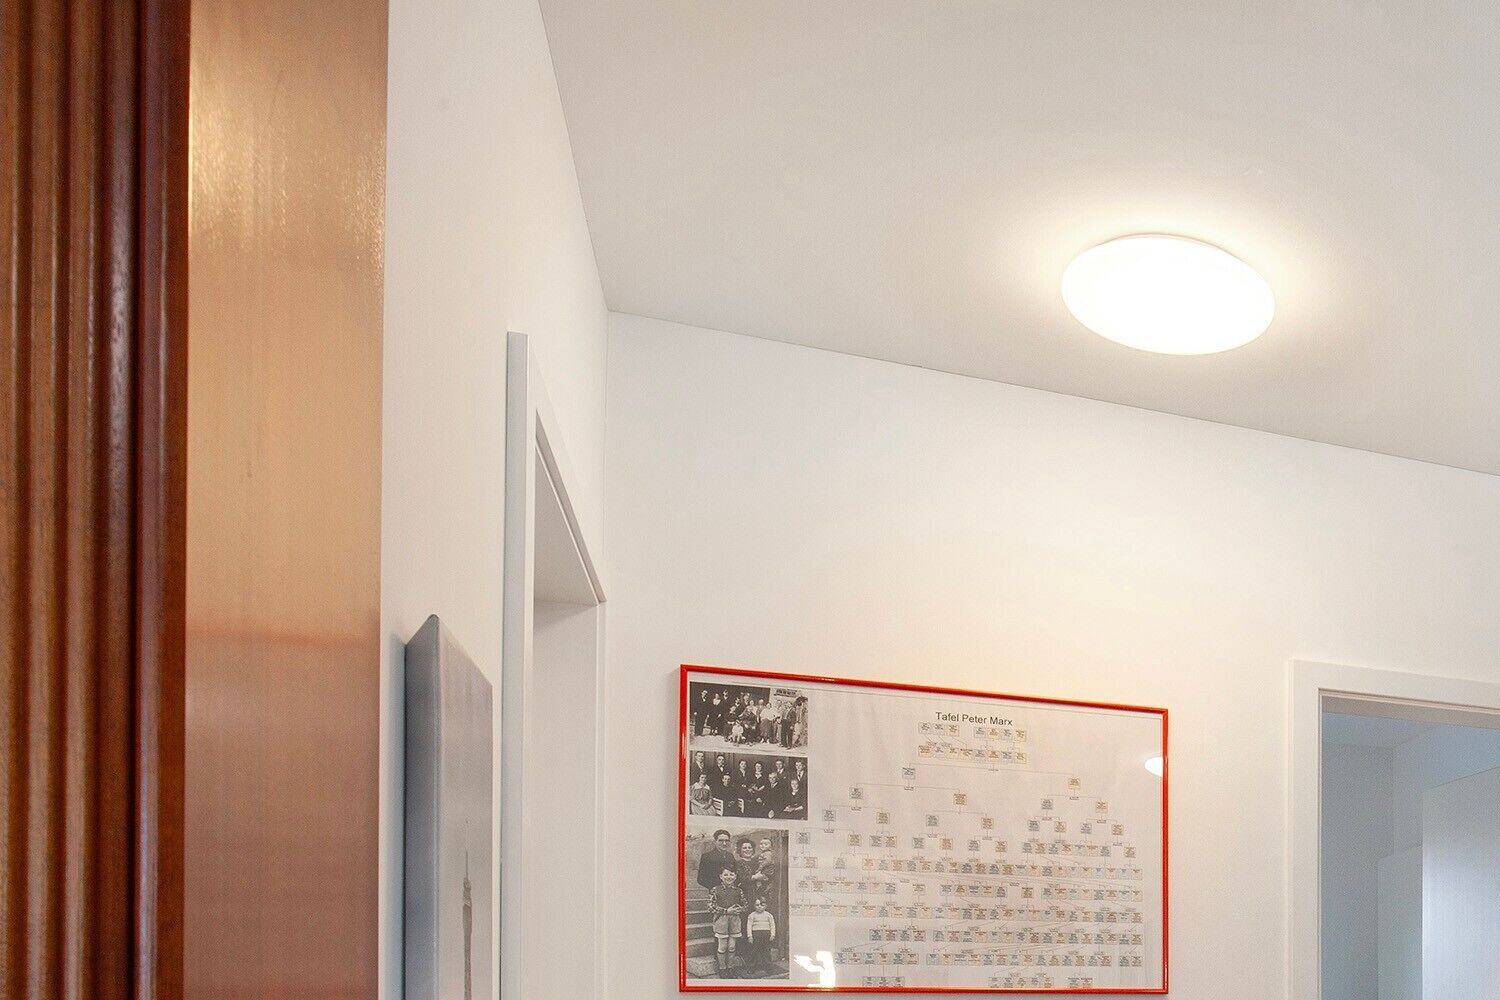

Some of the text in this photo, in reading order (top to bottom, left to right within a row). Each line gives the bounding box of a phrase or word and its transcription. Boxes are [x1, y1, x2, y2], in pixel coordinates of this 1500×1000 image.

[935, 711, 1013, 726] Tafel Peter Marx
